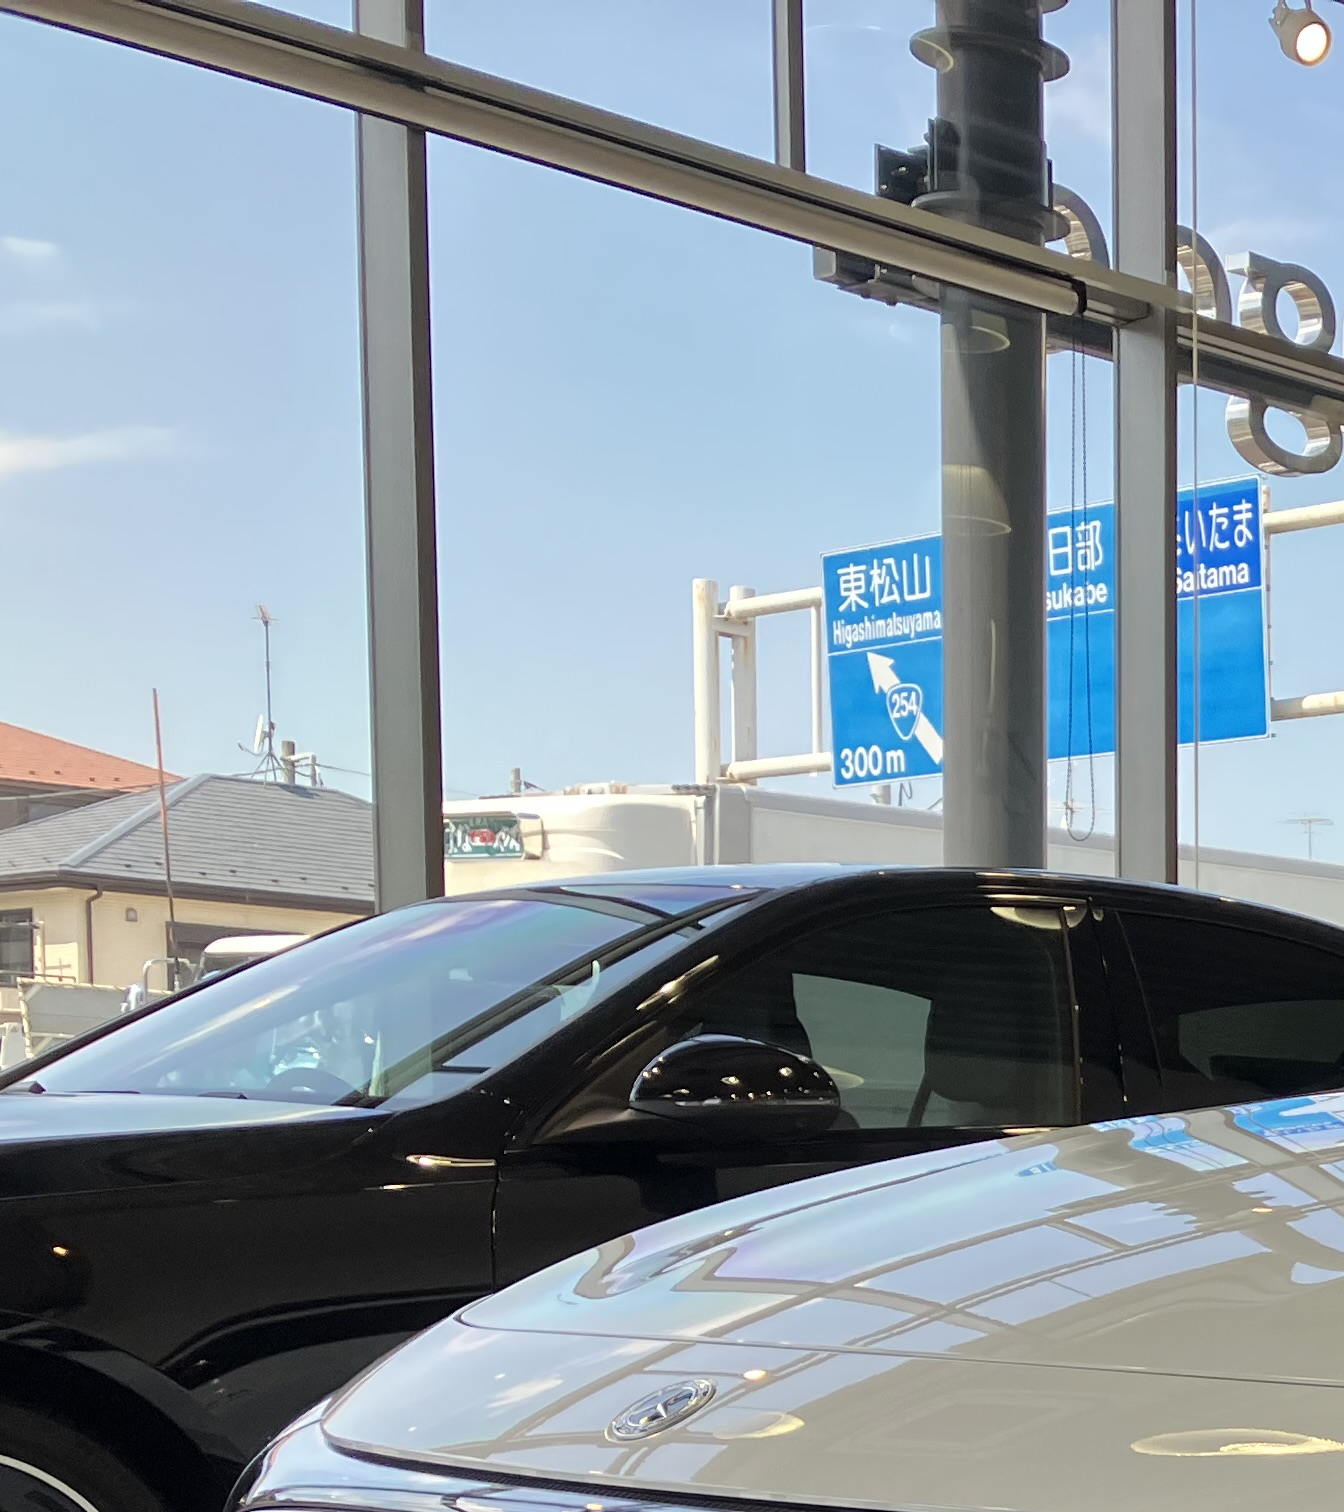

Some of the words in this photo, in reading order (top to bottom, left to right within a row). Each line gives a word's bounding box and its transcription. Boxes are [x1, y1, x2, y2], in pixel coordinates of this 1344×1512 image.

[1049, 520, 1103, 576] 日部
[837, 553, 931, 612] 東松山
[1046, 581, 1108, 611] sukabe
[833, 610, 942, 648] Higashimatsuyama
[891, 691, 917, 718] 254
